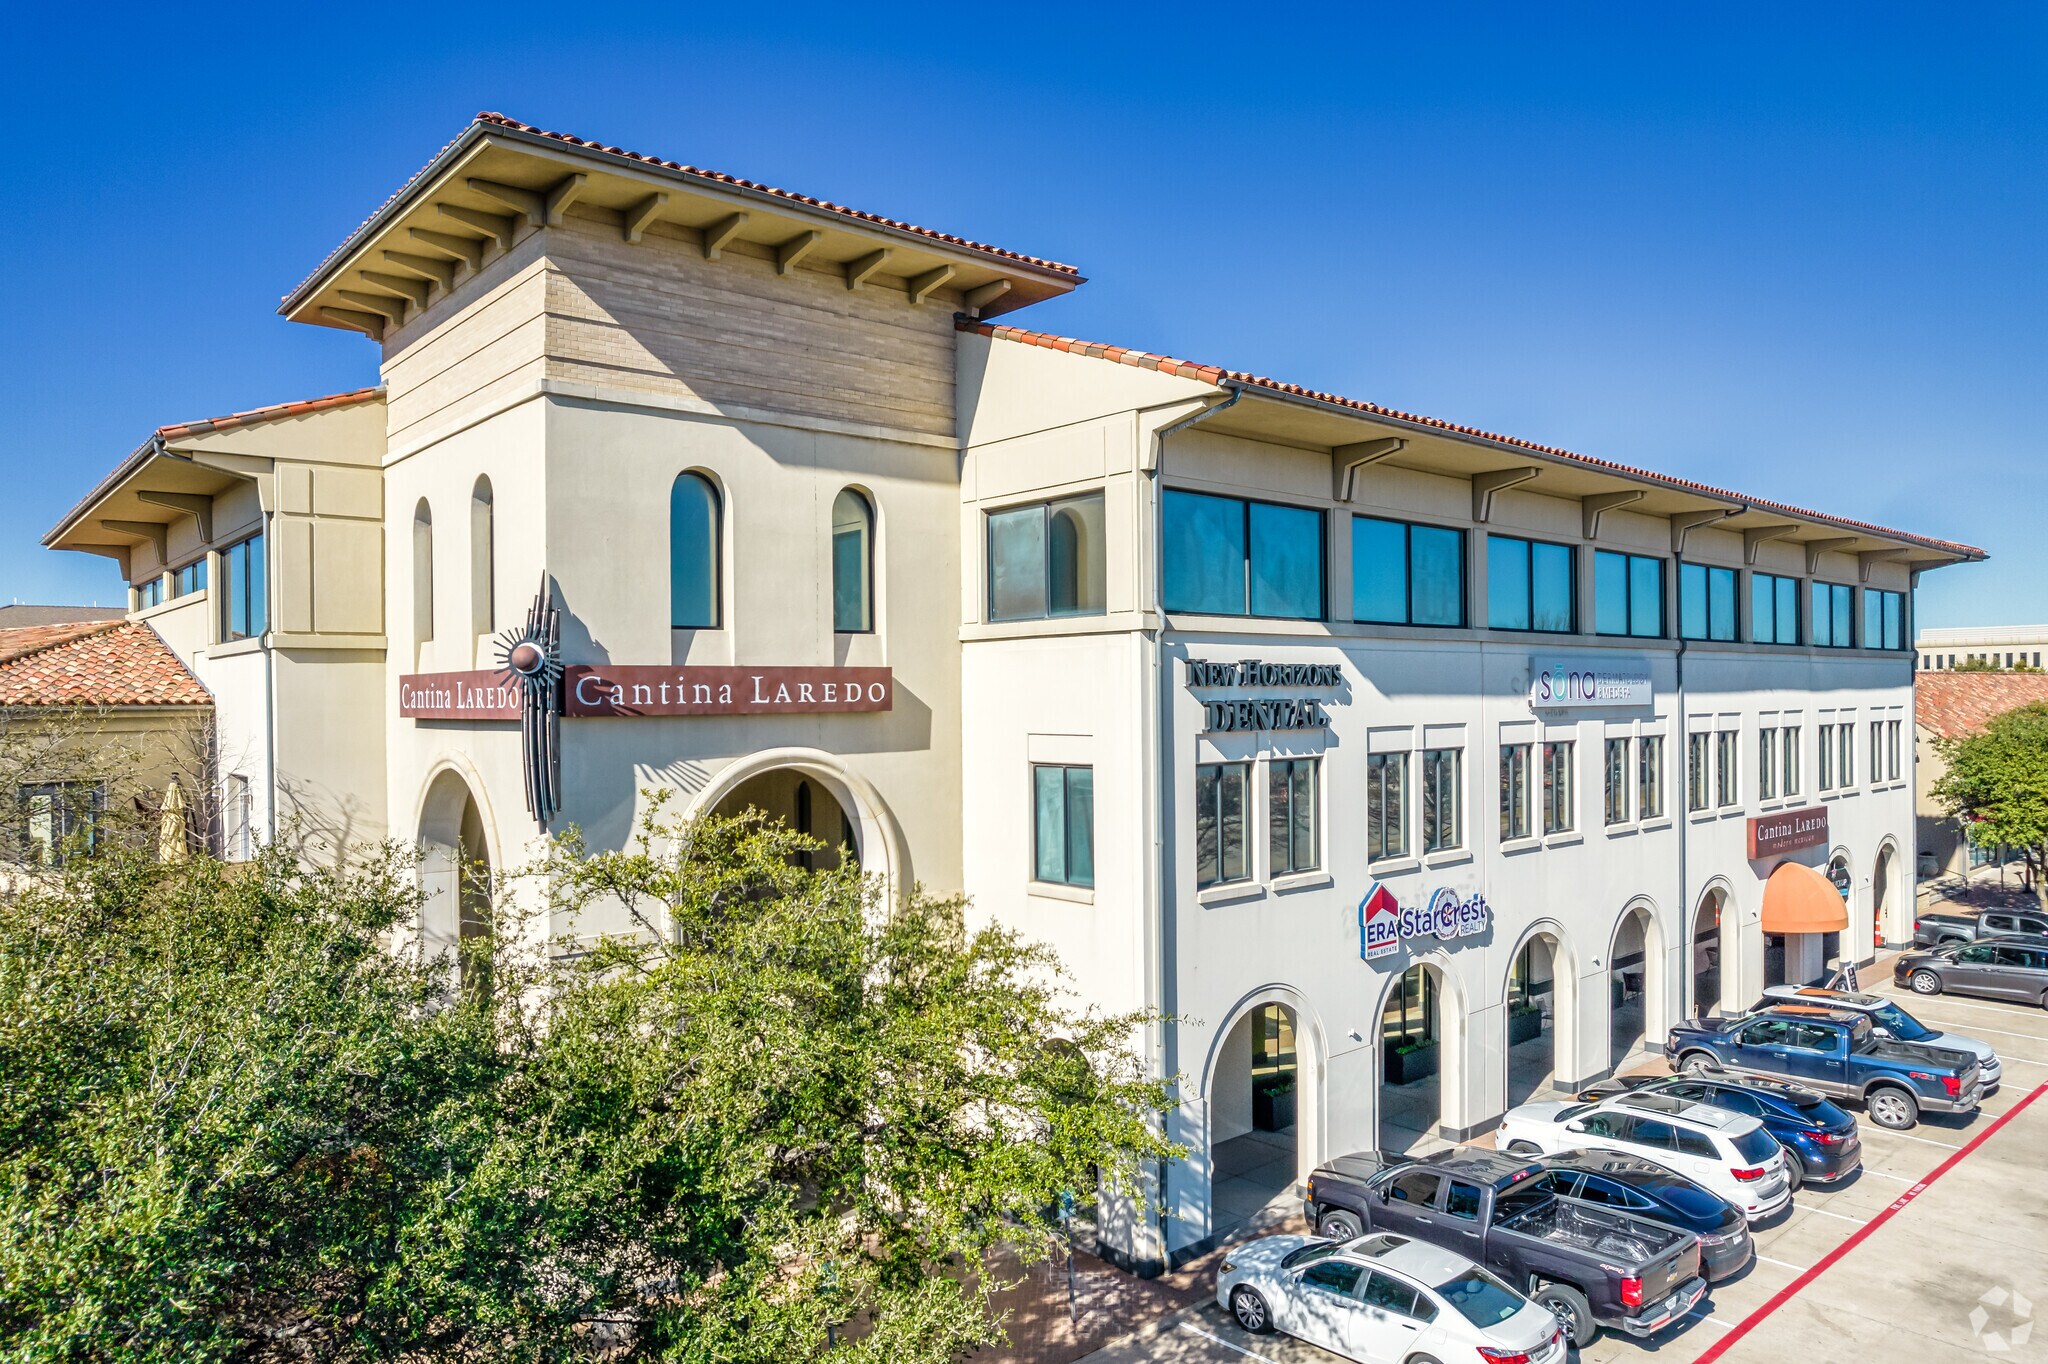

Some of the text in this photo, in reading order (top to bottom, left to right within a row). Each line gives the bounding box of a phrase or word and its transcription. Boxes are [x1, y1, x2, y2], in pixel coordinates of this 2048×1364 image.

[1186, 659, 1342, 687] NEW HORIZONS
[402, 681, 519, 709] Cantina LAREDO
[575, 675, 886, 706] Cantina LAREDO
[1203, 699, 1329, 733] DENTAL
[1758, 817, 1827, 841] Cantina LAREDO
[1403, 896, 1486, 937] StarCrest
[1461, 921, 1485, 934] REALTY
[1367, 920, 1397, 943] ERA
[1380, 946, 1398, 954] ESTATE
